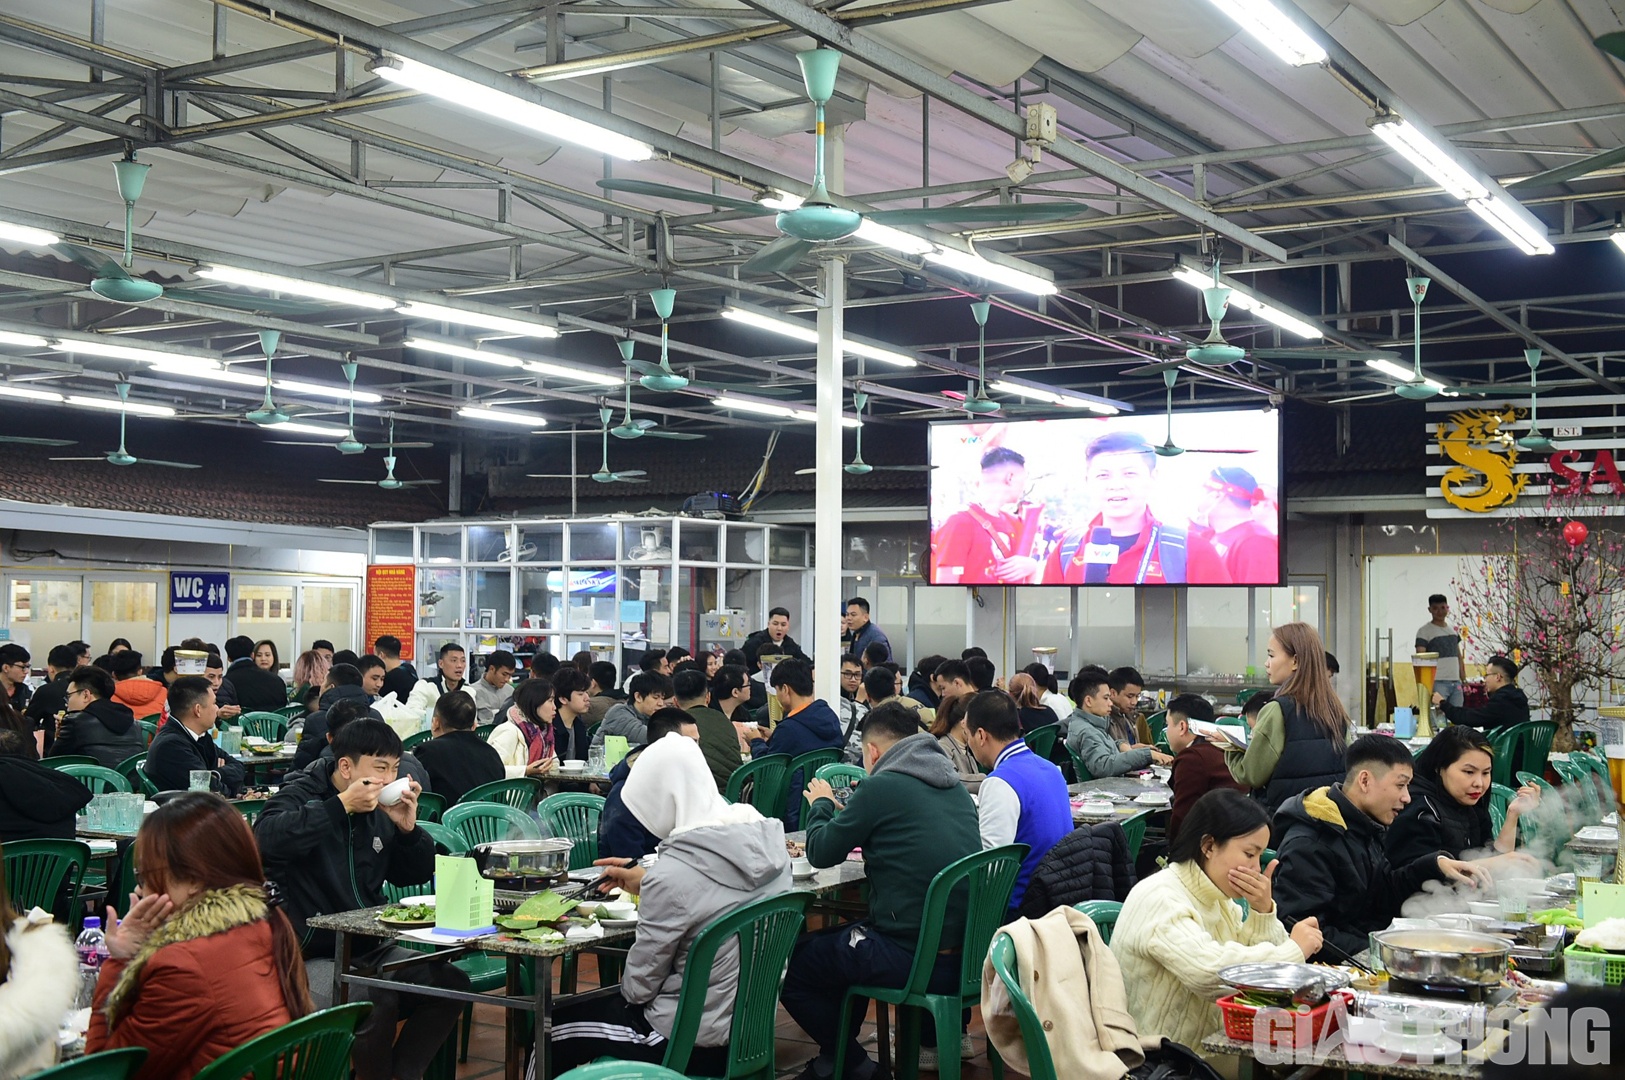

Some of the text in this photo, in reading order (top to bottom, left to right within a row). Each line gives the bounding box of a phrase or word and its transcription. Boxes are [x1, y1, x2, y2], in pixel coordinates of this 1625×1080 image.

[1557, 427, 1579, 436] EST.
[174, 577, 203, 598] WC
[705, 620, 719, 628] Tiger
